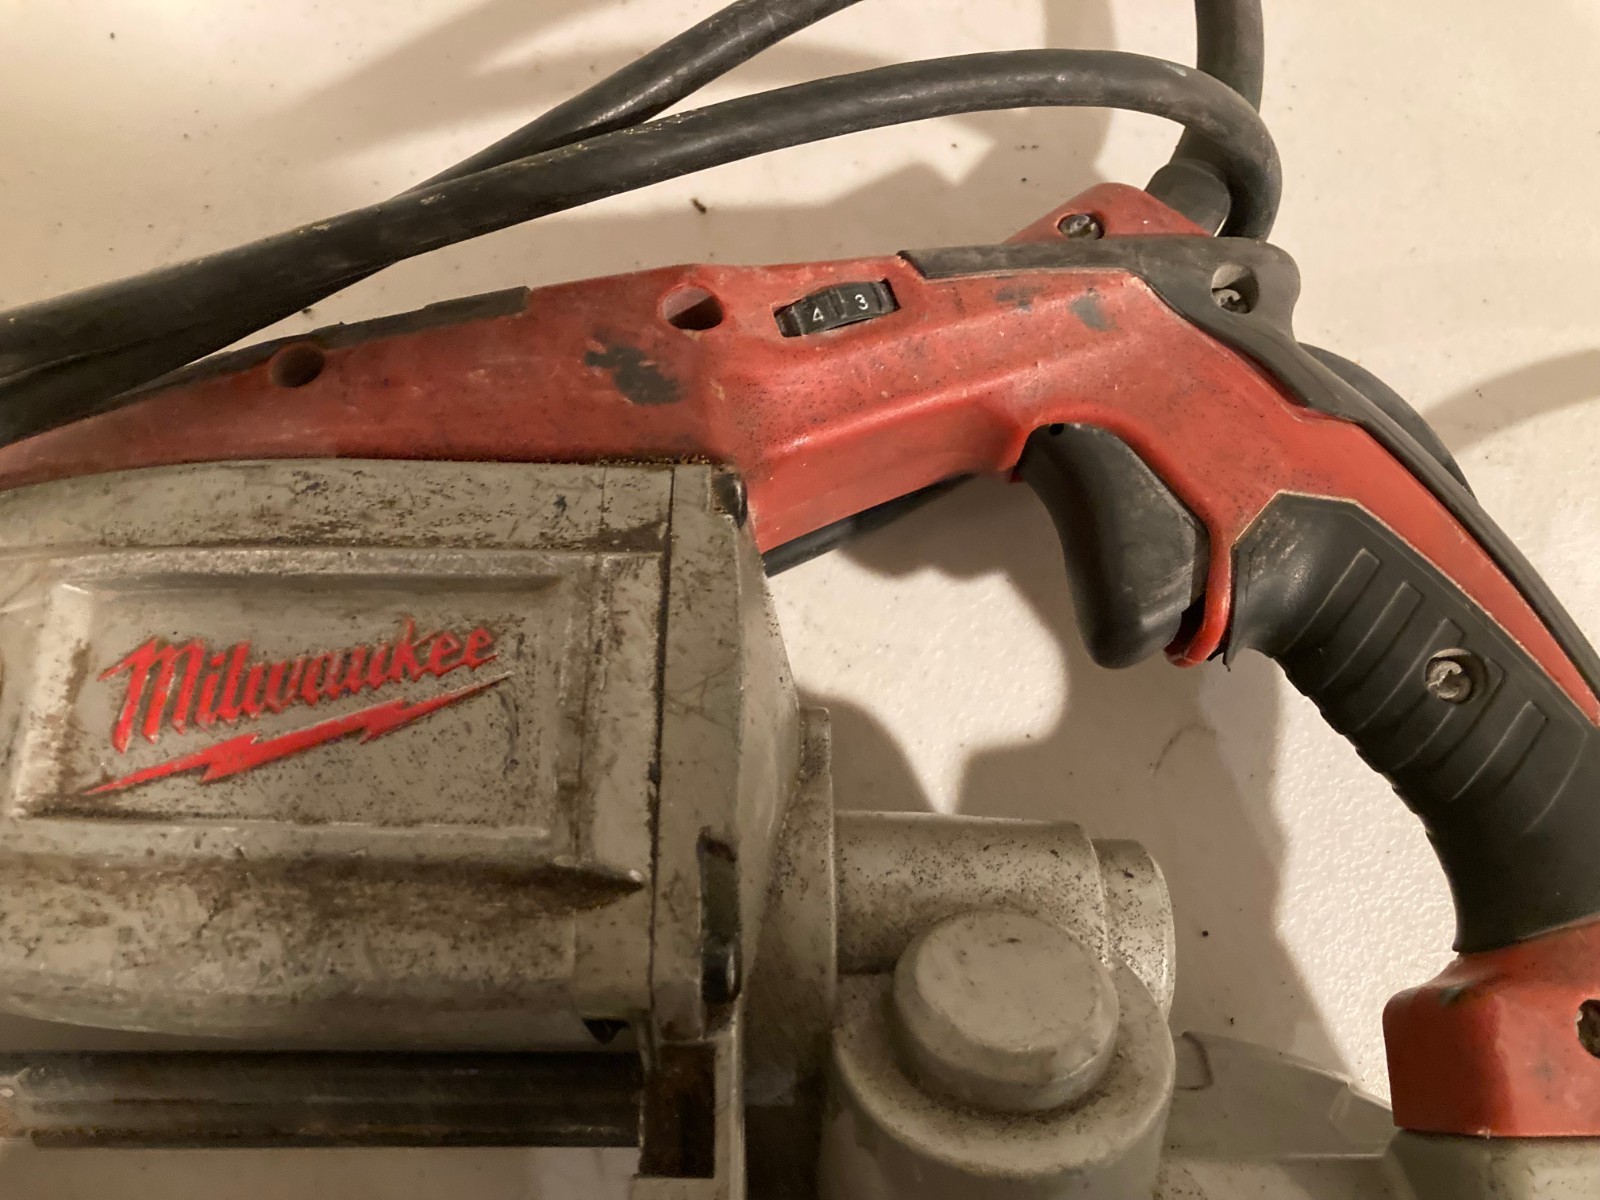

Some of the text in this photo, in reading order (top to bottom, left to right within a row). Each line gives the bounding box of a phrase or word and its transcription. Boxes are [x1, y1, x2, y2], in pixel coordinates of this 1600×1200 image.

[812, 293, 869, 322] 4 3
[97, 617, 500, 753] Milwaukee
